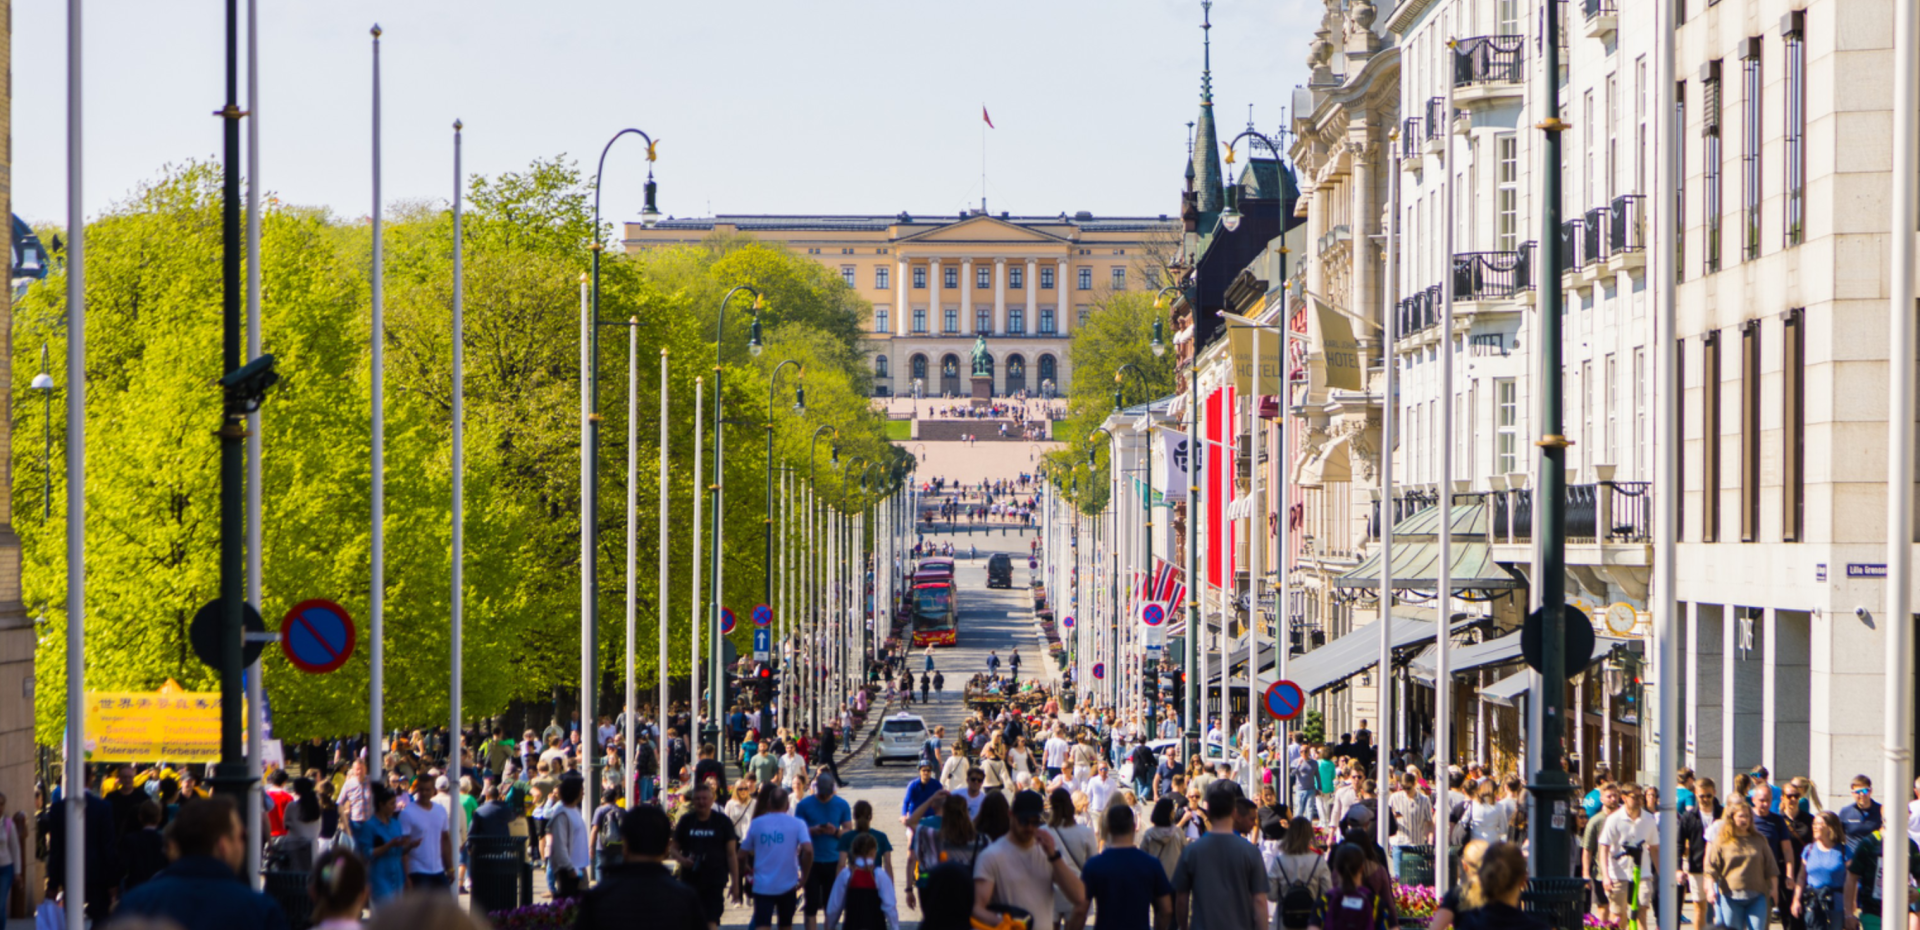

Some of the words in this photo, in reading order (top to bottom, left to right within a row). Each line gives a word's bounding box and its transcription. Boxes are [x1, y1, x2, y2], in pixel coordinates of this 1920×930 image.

[1325, 351, 1361, 369] HOTEL
[163, 725, 221, 735] Truthfulnes
[101, 745, 151, 755] Toleranse
[161, 745, 221, 755] Forbearanc
